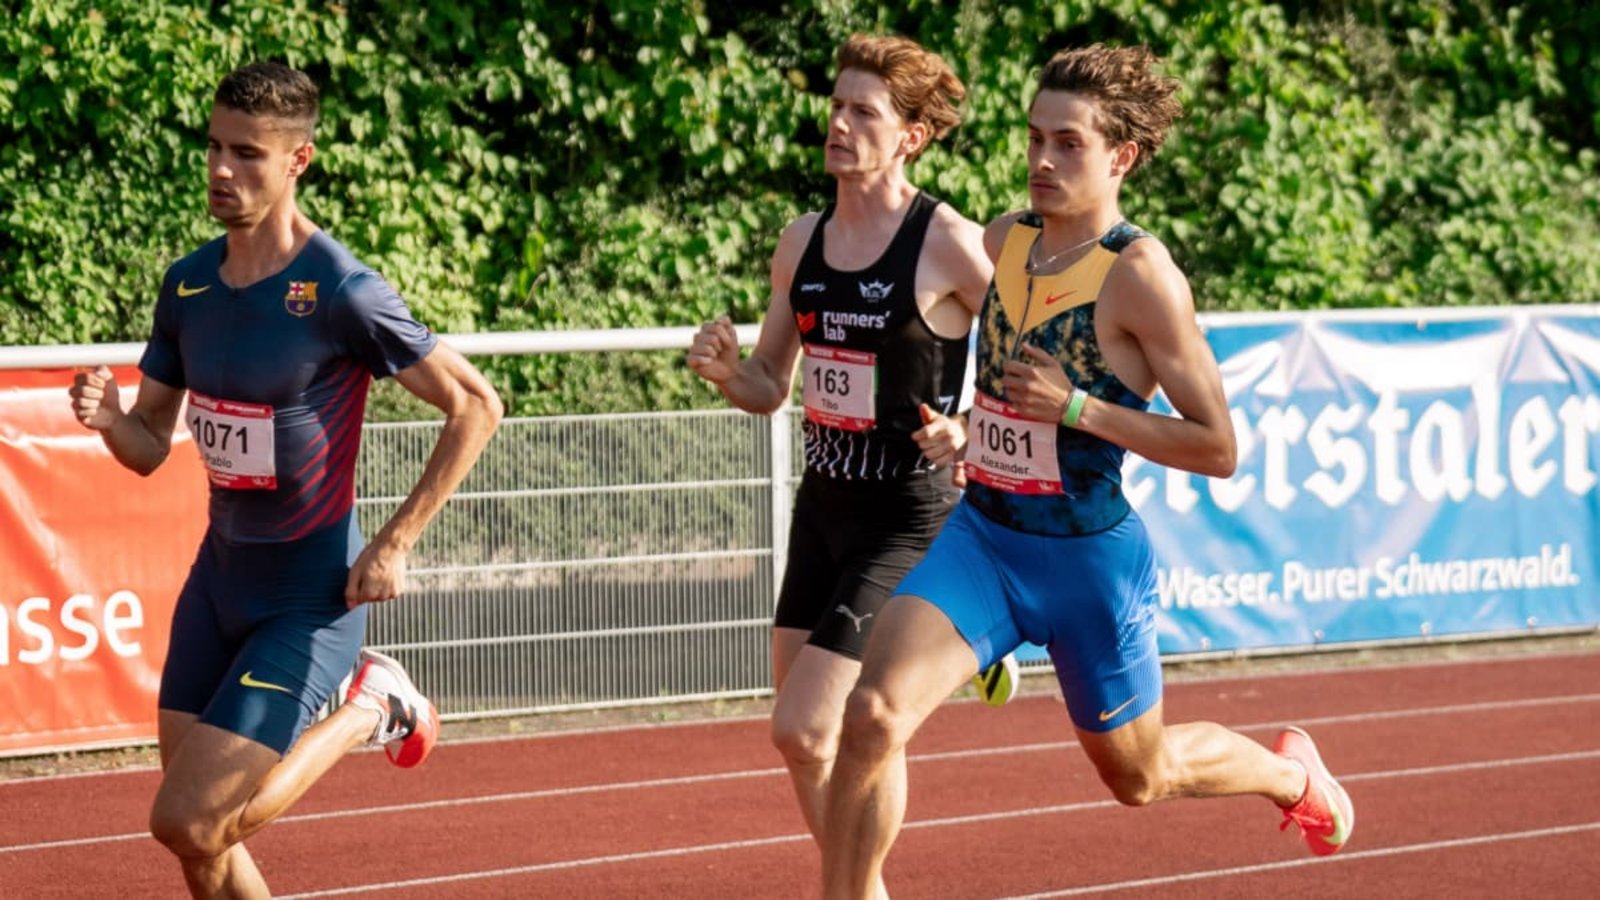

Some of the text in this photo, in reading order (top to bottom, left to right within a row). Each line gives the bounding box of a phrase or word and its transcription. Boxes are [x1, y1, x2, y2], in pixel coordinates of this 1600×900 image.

[823, 310, 891, 329] runners'
[823, 324, 847, 341] lab
[813, 366, 850, 396] 163
[193, 415, 248, 454] 1071
[977, 418, 1032, 459] 1061
[980, 454, 1030, 475] Alexander
[1156, 542, 1580, 609] Wasser. Purer Schwarzwald.
[0, 590, 144, 667] sse
